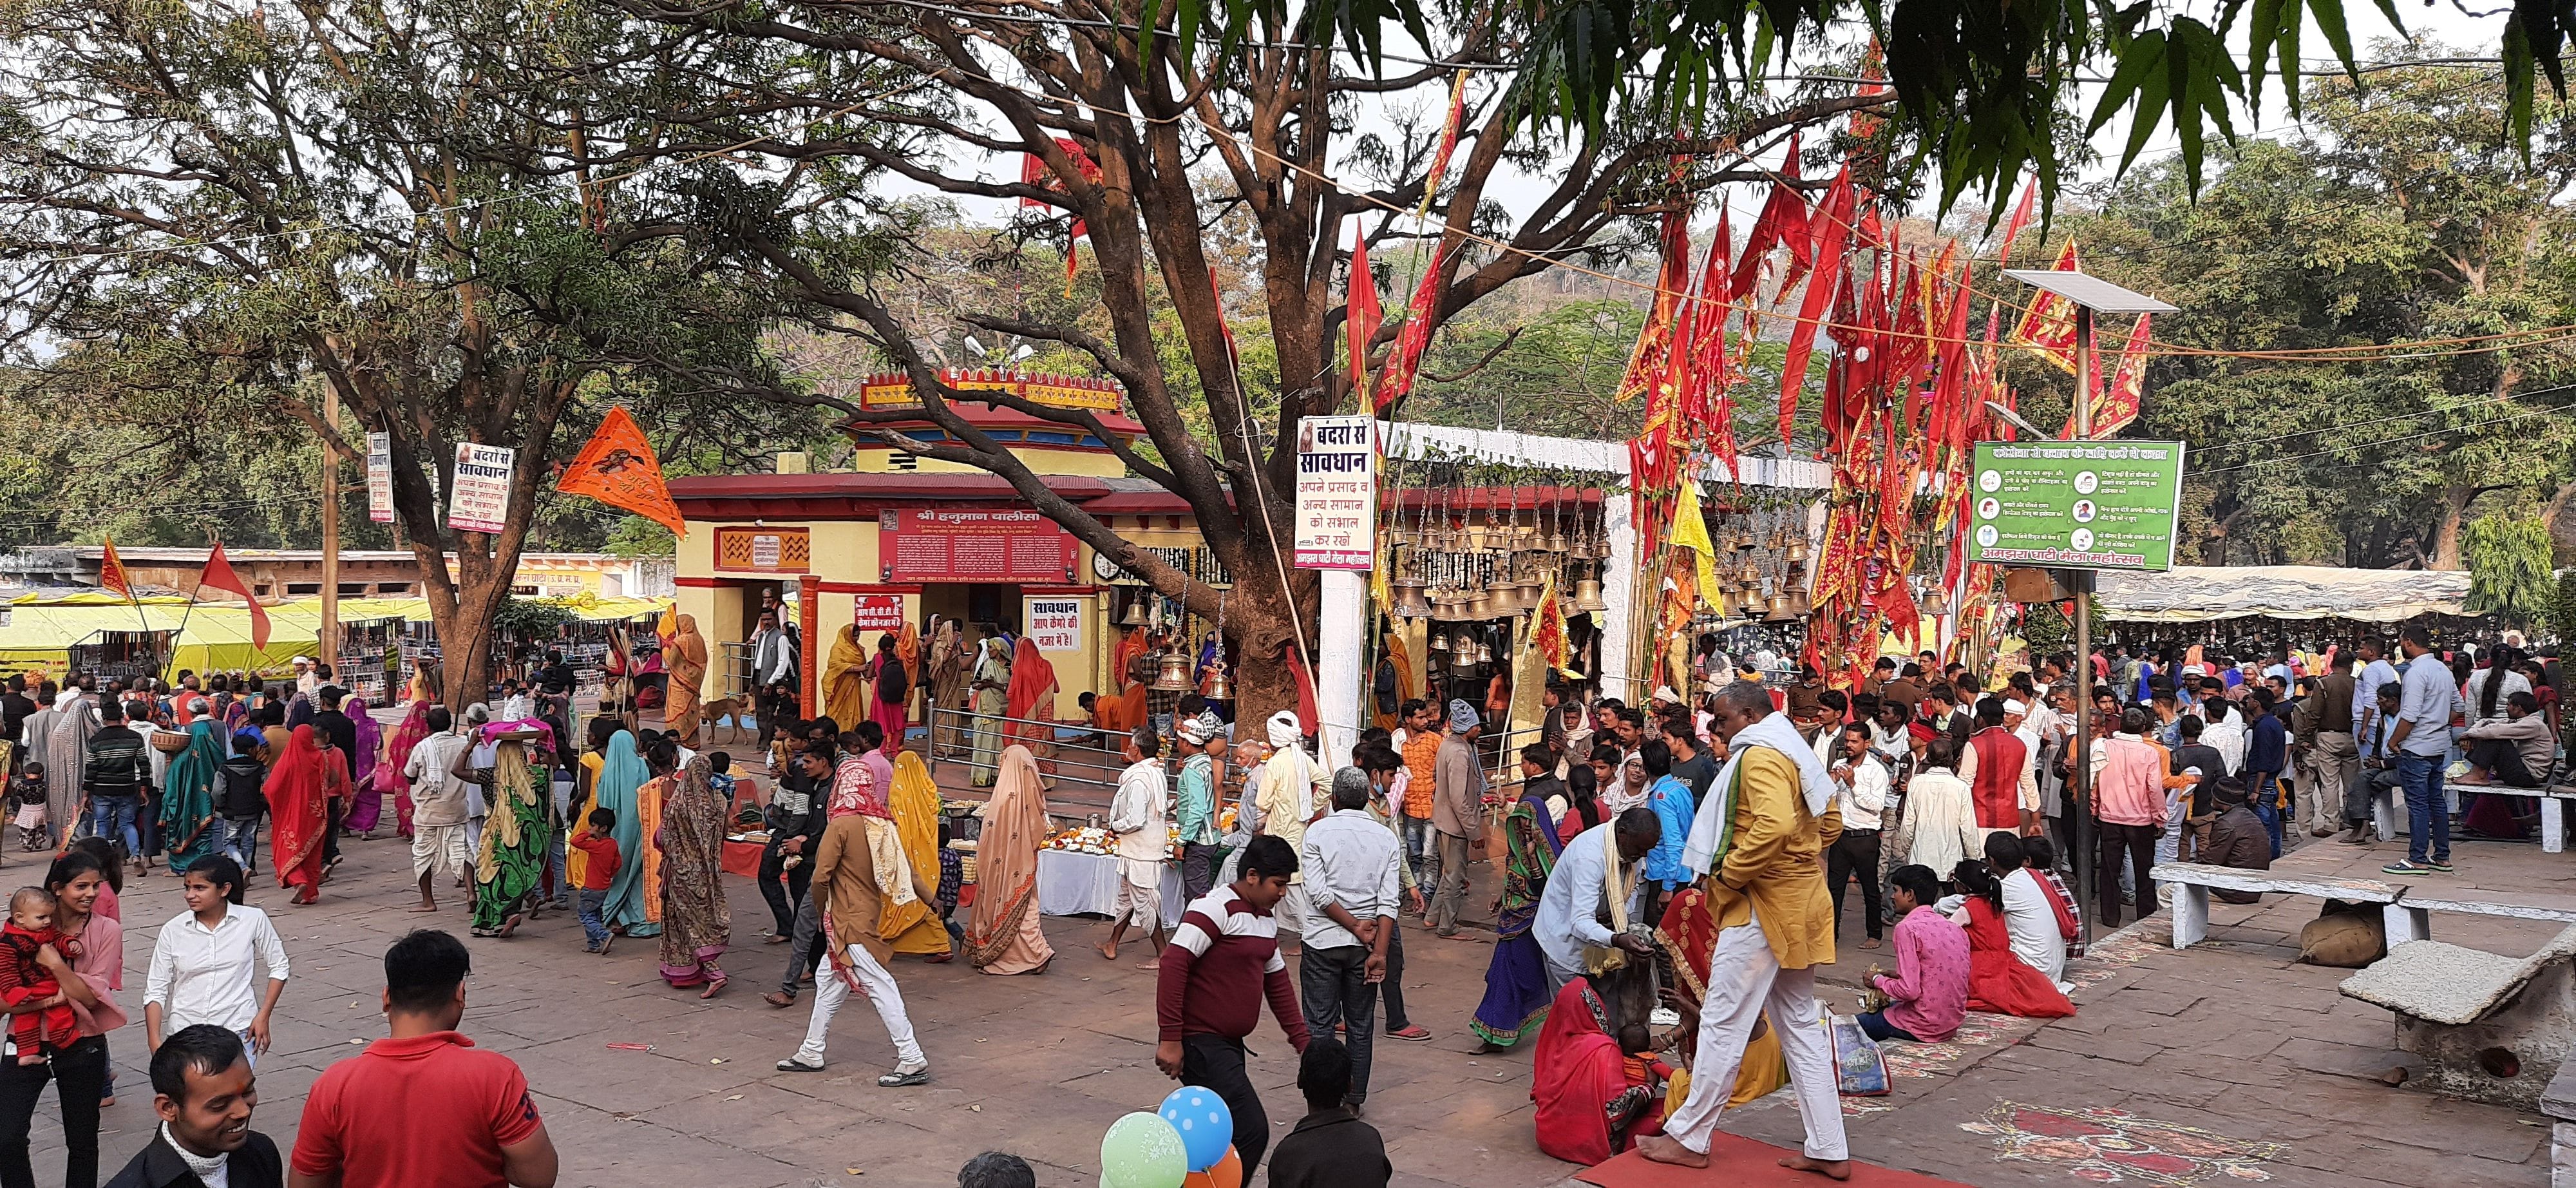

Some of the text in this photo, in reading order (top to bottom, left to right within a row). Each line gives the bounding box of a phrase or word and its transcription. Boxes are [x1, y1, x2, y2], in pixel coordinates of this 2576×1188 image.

[1318, 419, 1367, 445] बंदरो से
[500, 450, 510, 465] से
[1993, 446, 2029, 458] कोरोना
[2031, 446, 2041, 459] से
[2043, 448, 2070, 459] बचाव
[2071, 446, 2085, 459] के
[2129, 446, 2140, 459] ये
[2141, 449, 2167, 460] काम
[1300, 452, 1368, 473] सावधान
[459, 463, 509, 479] सावधान
[456, 478, 476, 487] अपने
[1299, 477, 1368, 493] अपने प्रसाद व
[1303, 500, 1364, 511] अन्य सामान
[916, 510, 1041, 524] श्री हनुमान चालीसा
[1310, 513, 1359, 528] को संभाल
[1314, 535, 1330, 546] कर
[1333, 532, 1352, 546] रखें
[1981, 547, 2145, 566] अमझरा घाटी मेला महोत्सव
[531, 571, 546, 582] घाटी
[1033, 602, 1078, 613] सावधान
[1033, 615, 1077, 629] आप कैमरे की
[1039, 636, 1054, 646] नजर
